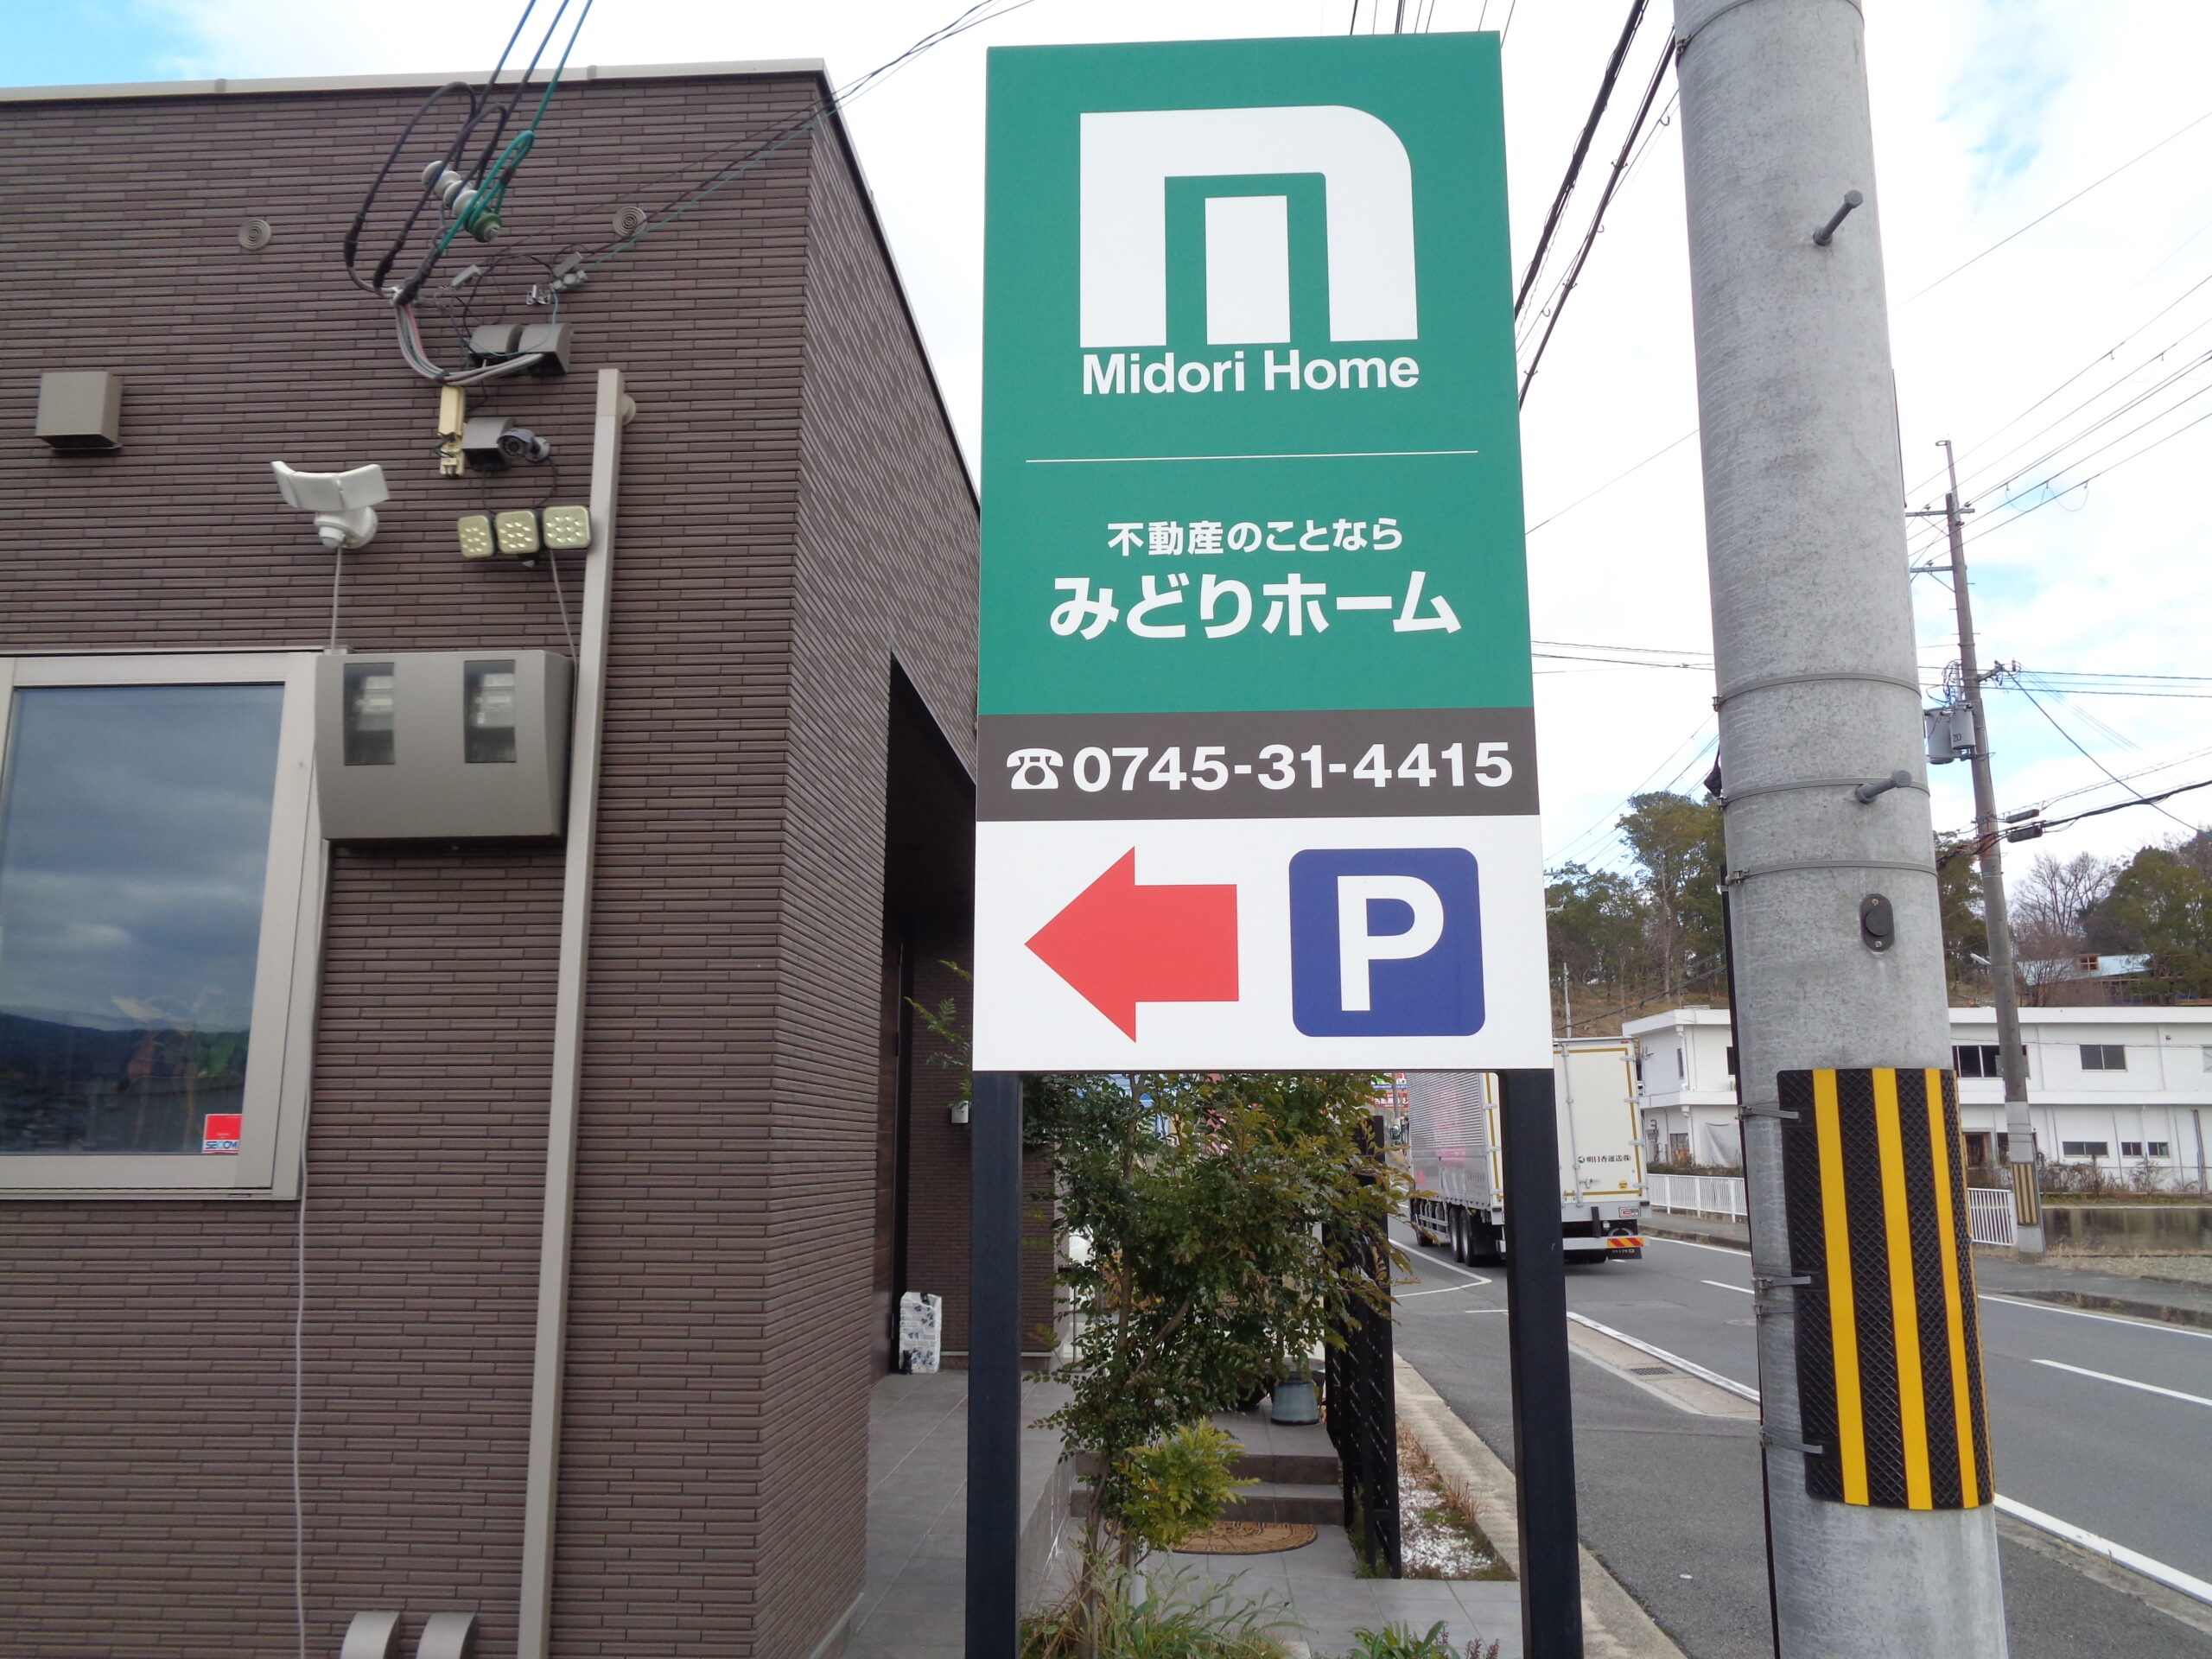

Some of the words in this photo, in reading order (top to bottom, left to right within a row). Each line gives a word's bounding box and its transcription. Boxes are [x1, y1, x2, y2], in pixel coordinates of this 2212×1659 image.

[1083, 350, 1245, 395] Midori
[1264, 348, 1420, 391] Home
[1107, 518, 1404, 557] 不動産のことなら
[1049, 570, 1462, 640] みどりホーム
[1952, 733, 1962, 742] 20
[1071, 741, 1514, 792] 0745-31-4415
[1337, 874, 1445, 1012] P
[206, 1141, 238, 1150] SECOM
